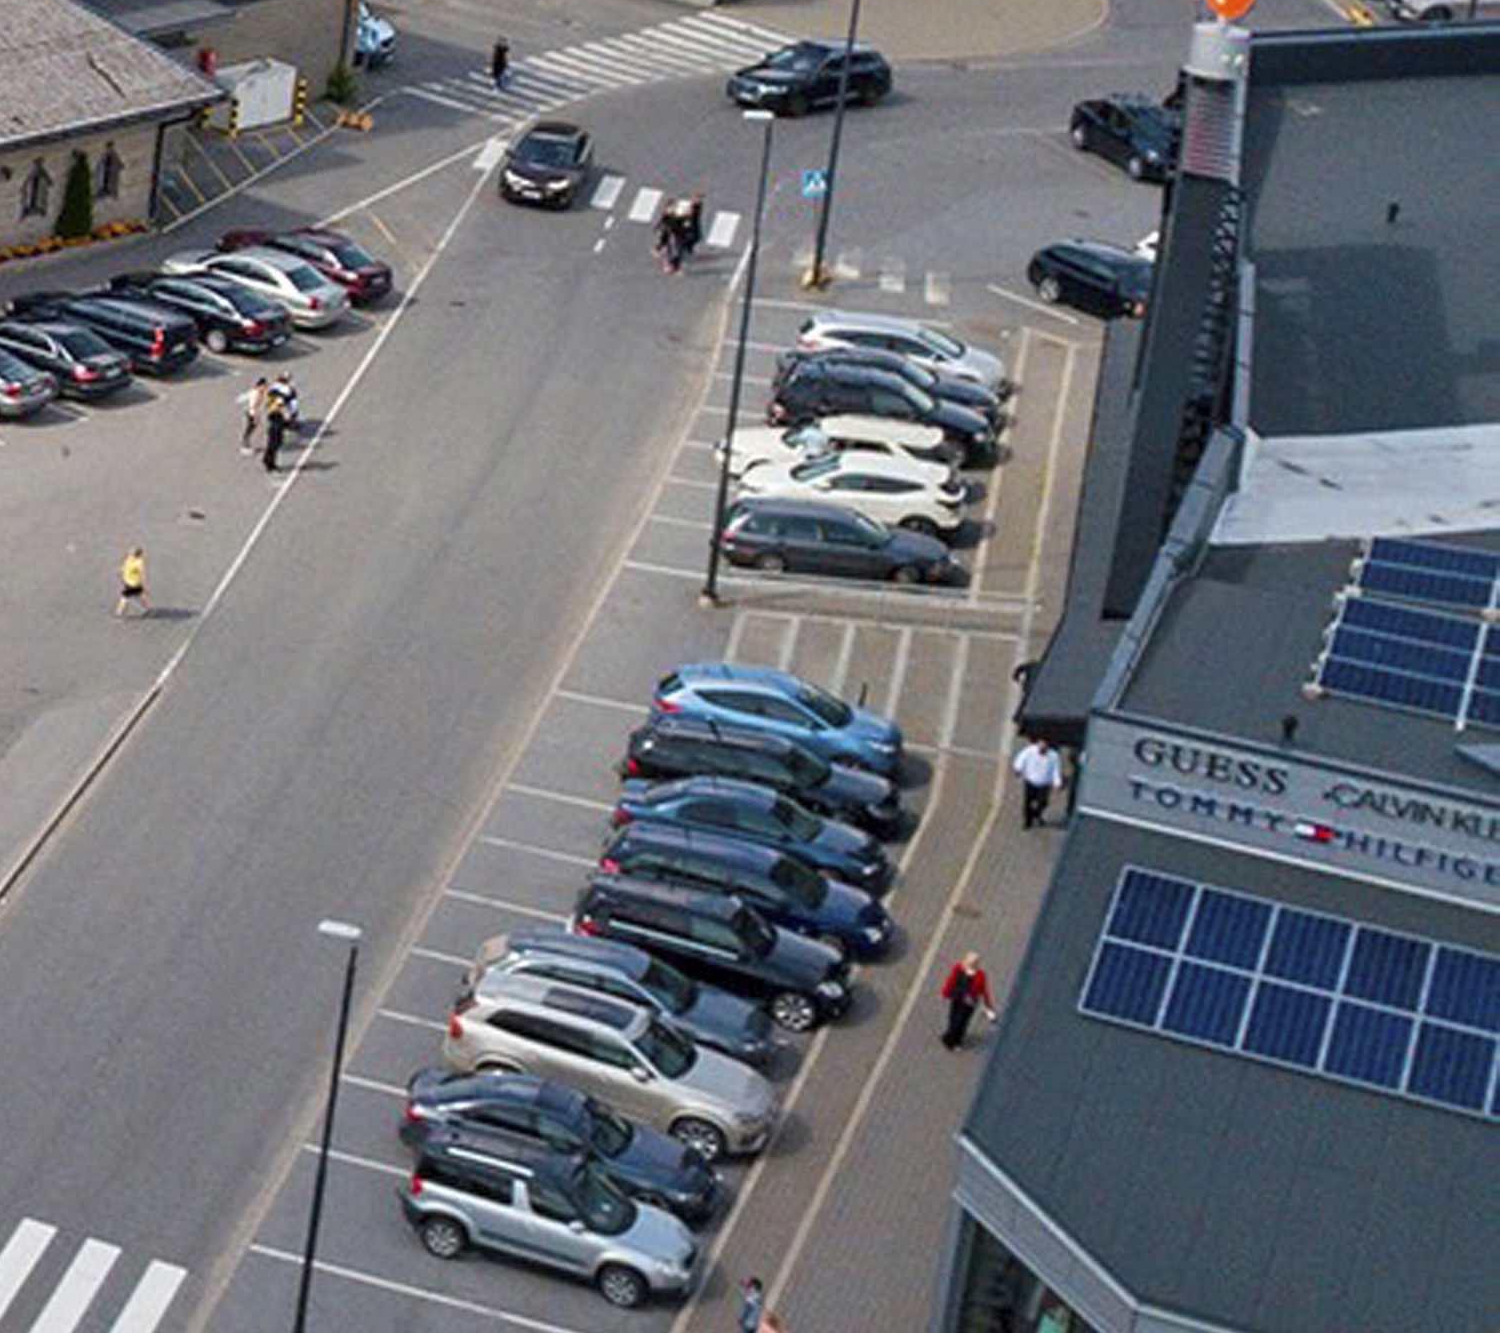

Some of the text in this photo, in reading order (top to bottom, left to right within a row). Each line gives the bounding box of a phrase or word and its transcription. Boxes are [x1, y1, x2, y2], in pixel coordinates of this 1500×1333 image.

[1134, 737, 1289, 795] GUESS
[1130, 780, 1284, 832] TOMMY
[1324, 783, 1445, 828] CALVIN
